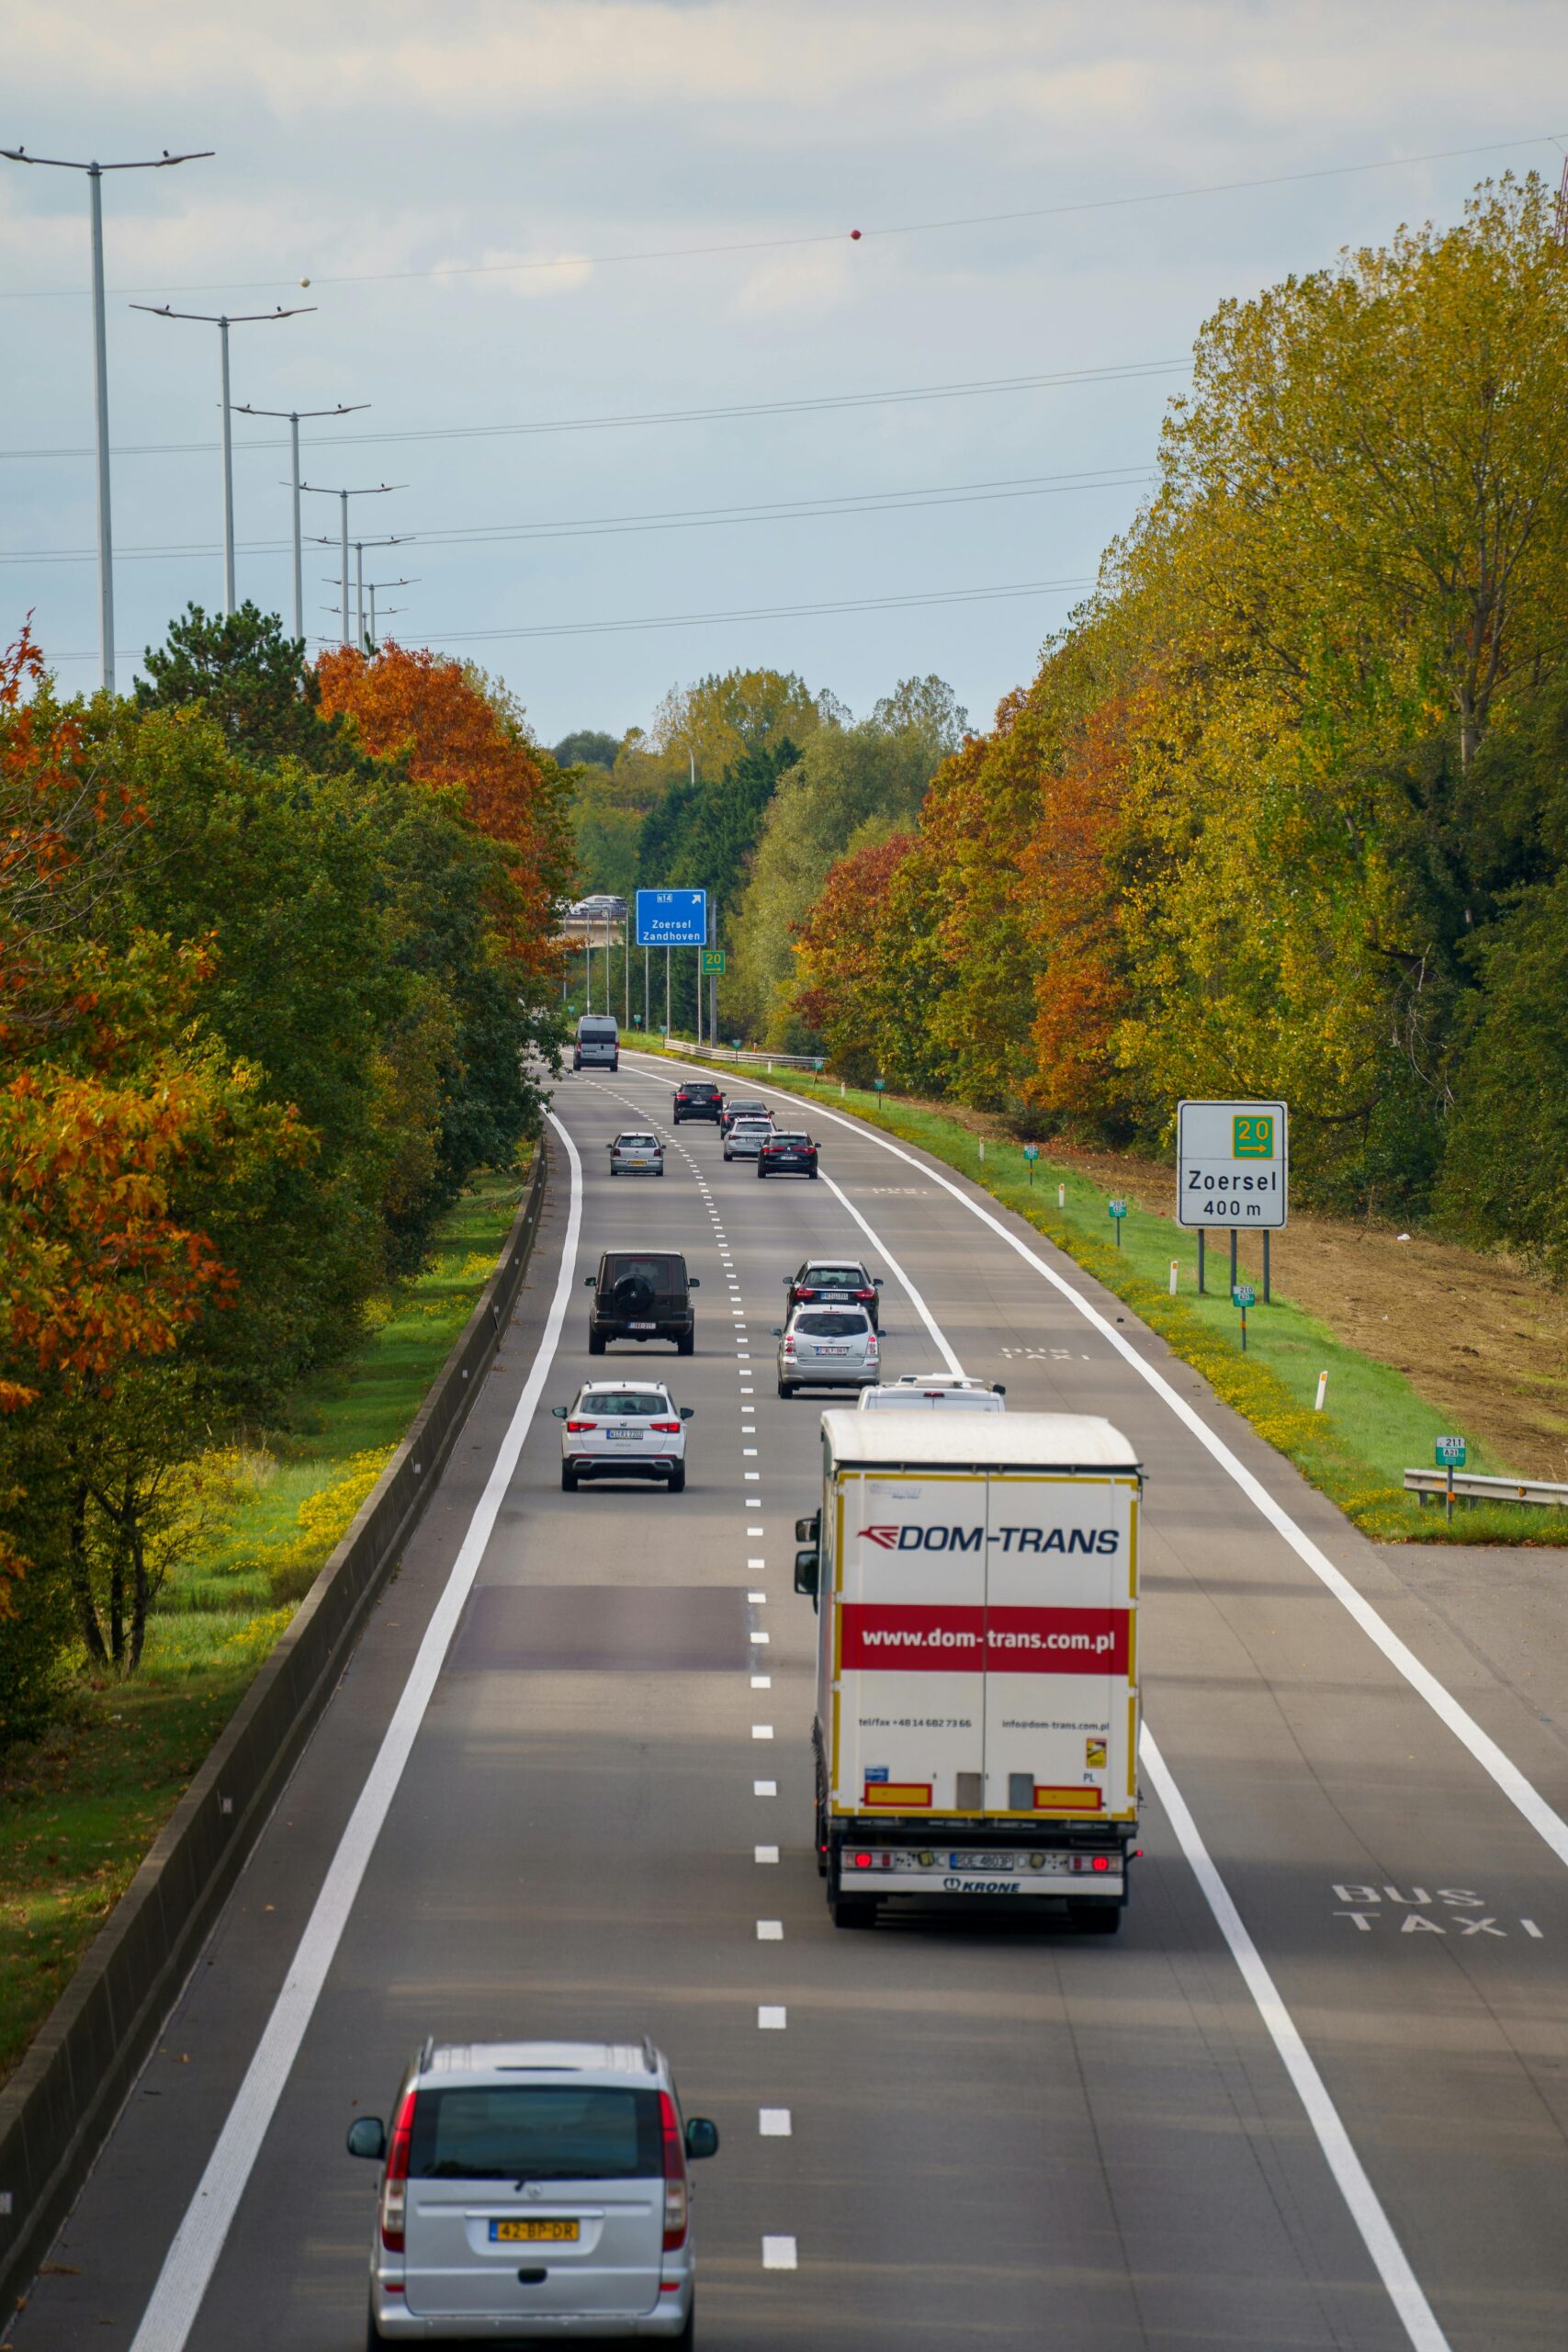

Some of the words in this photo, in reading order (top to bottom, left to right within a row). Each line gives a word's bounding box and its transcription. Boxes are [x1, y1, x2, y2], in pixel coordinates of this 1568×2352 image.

[652, 920, 692, 929] Zoersel
[643, 932, 700, 941] Zandhoven
[705, 953, 721, 965] 20
[1238, 1120, 1269, 1140] 20
[1189, 1170, 1276, 1191] Zoersel
[1203, 1200, 1240, 1216] 400
[1247, 1204, 1260, 1216] m
[1446, 1438, 1461, 1447] 21.1
[897, 1525, 1120, 1555] DOM-TRANS
[863, 1628, 1114, 1654] www.dom-trans.com.pl
[859, 1717, 890, 1727] tel/fax
[892, 1718, 911, 1728] +48
[913, 1718, 924, 1728] 14
[946, 1719, 957, 1728] 73
[1002, 1720, 1110, 1732] info@dom-trans.com.pl
[1083, 1772, 1095, 1783] PL
[963, 1882, 1021, 1893] KRONE
[1332, 1885, 1484, 1907] BUS
[1333, 1912, 1544, 1939] TAXI
[502, 2222, 574, 2238] 42-BP-DR
